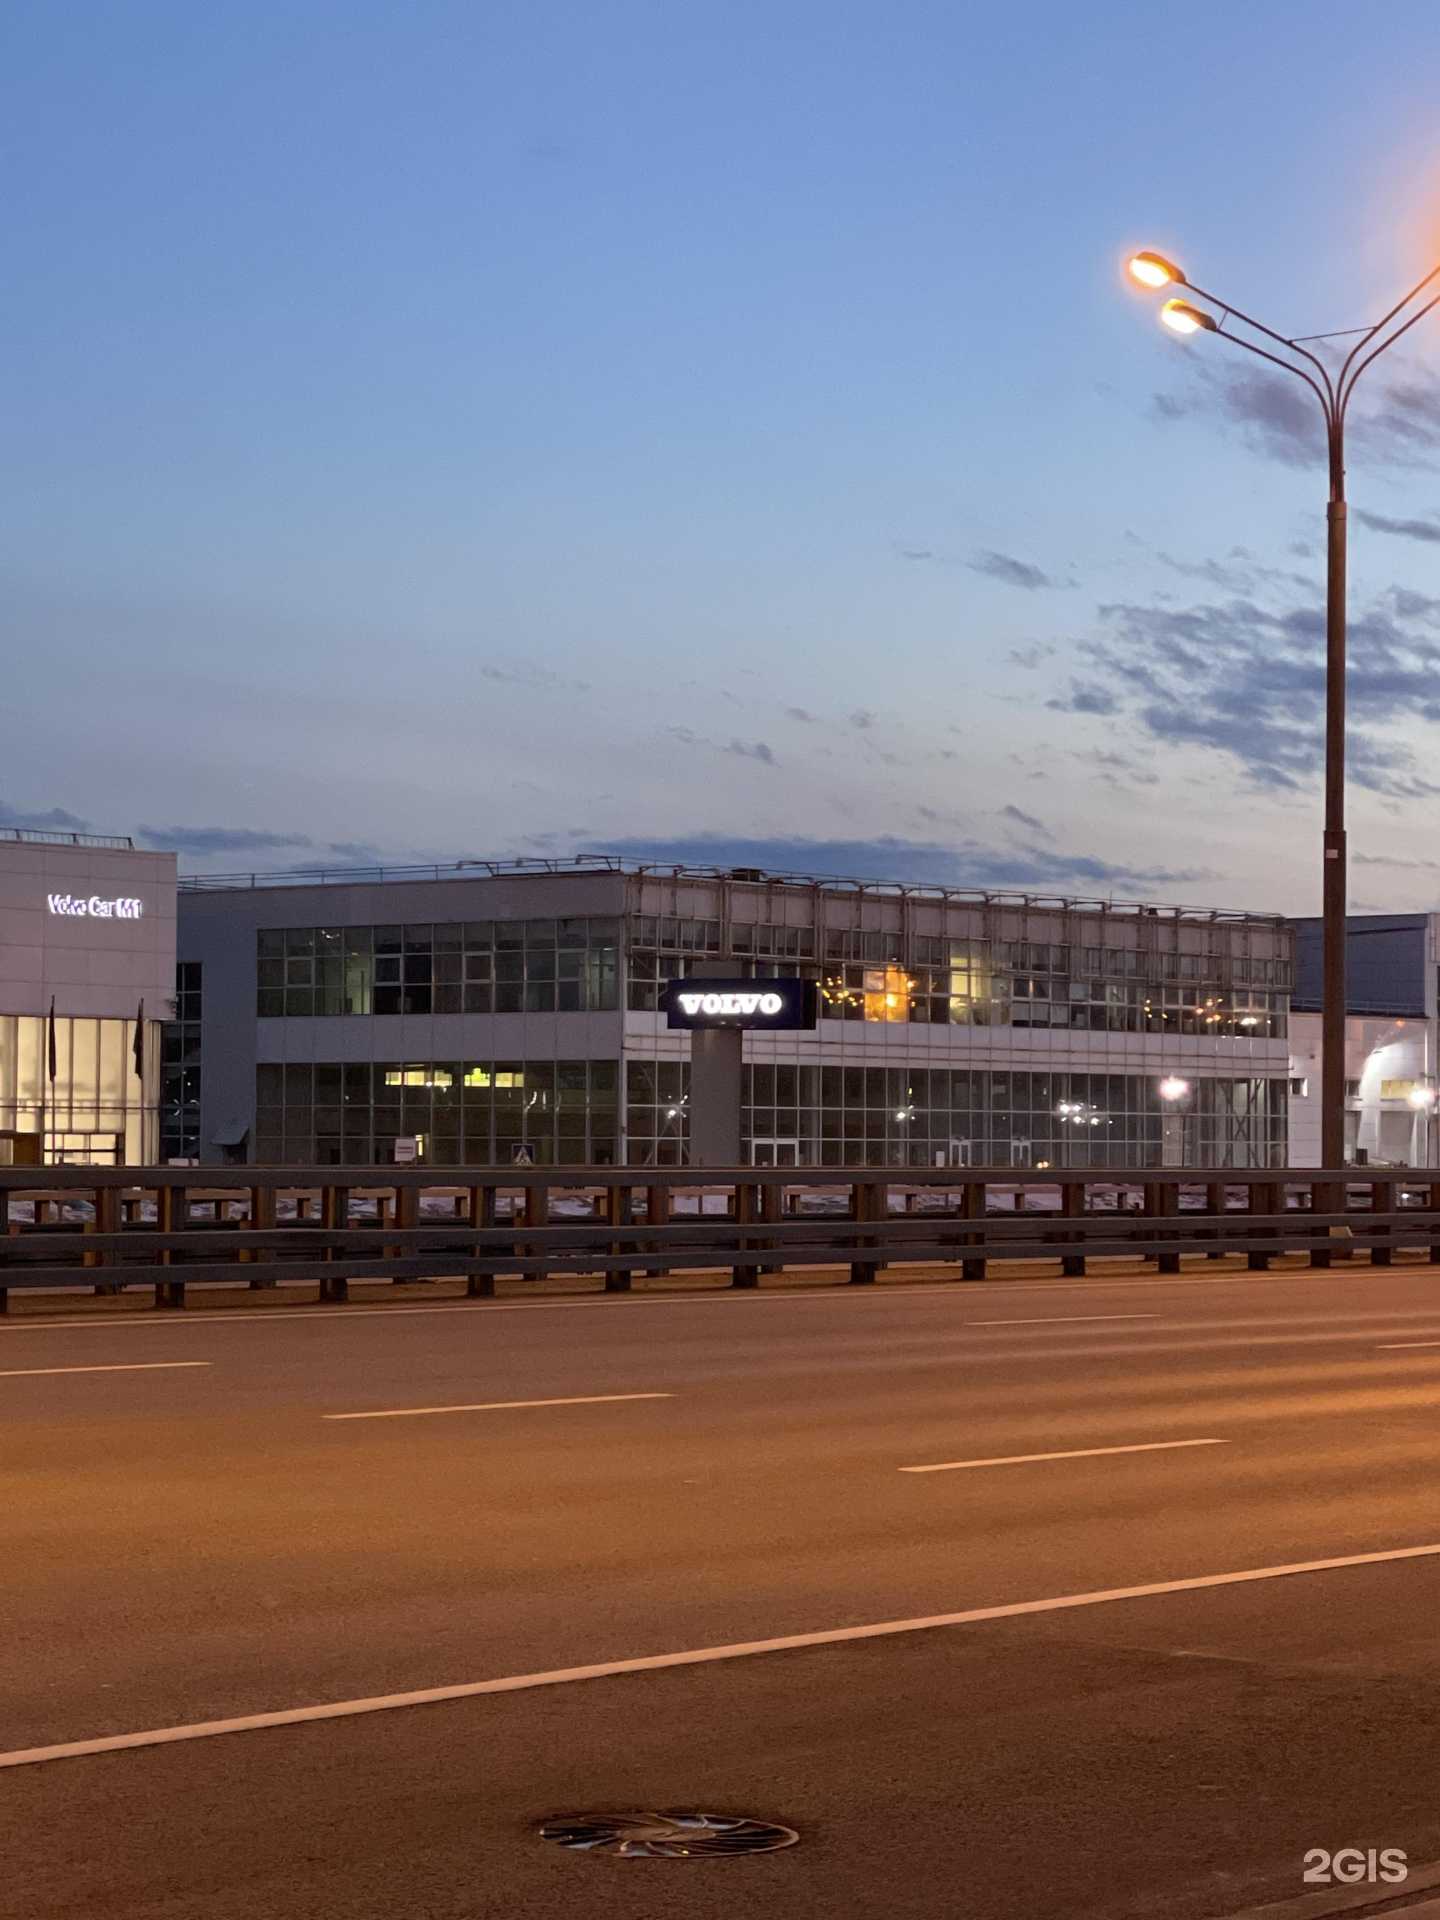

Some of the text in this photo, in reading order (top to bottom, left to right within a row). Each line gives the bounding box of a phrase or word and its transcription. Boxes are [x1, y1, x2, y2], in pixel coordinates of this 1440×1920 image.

[47, 894, 87, 915] Volvo
[88, 896, 115, 917] Car
[678, 993, 782, 1014] VOLVO
